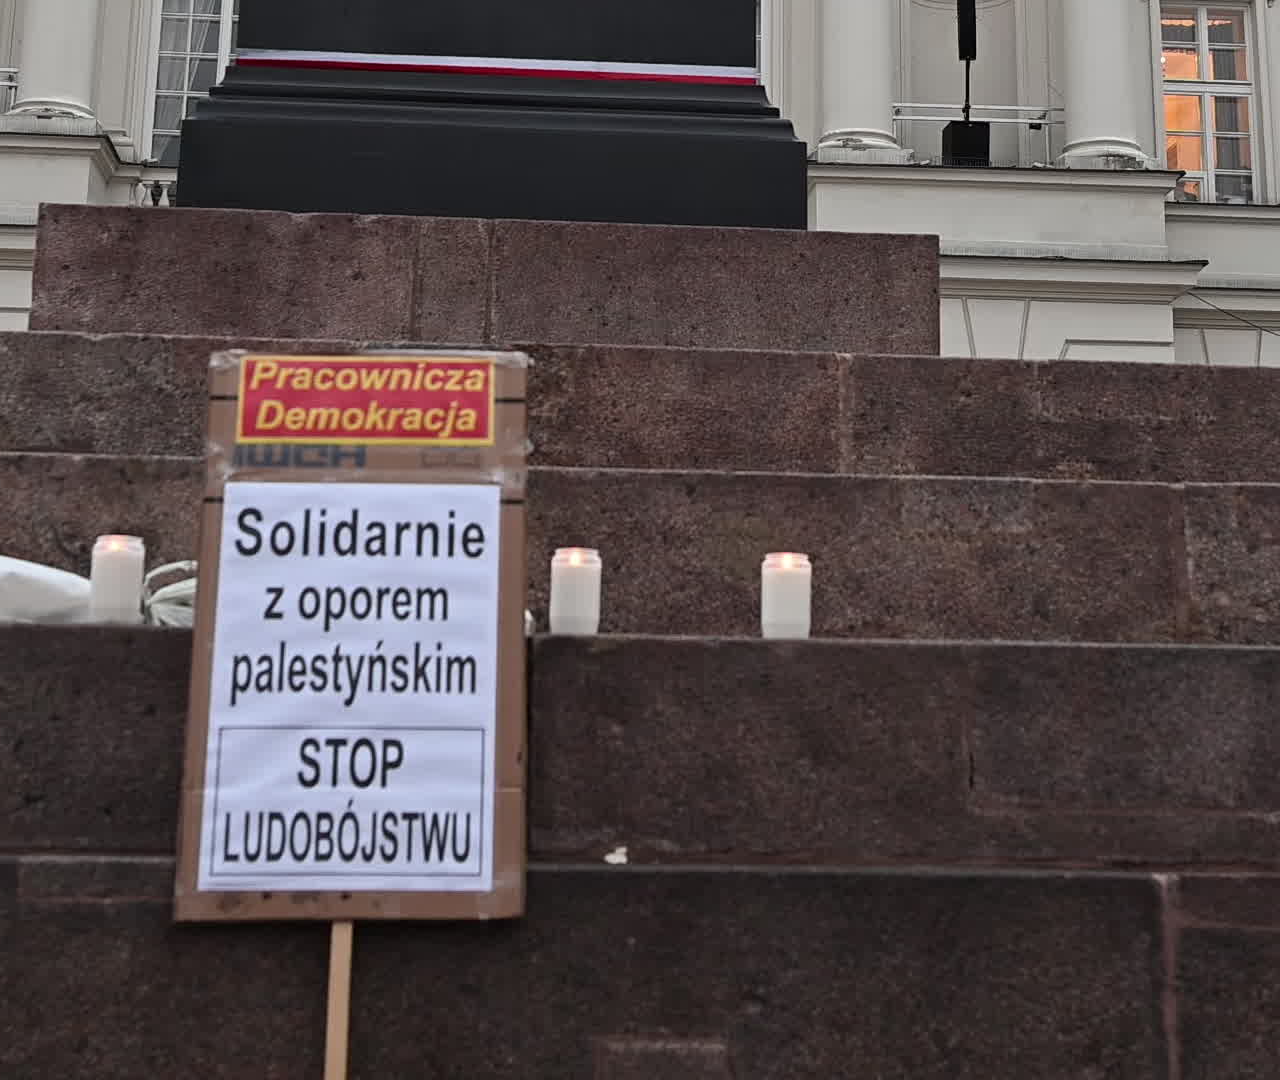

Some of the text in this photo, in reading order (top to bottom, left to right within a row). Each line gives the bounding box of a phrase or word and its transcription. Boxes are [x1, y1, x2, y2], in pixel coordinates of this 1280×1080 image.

[249, 360, 486, 392] Pracownicza
[255, 400, 478, 437] Demokracja
[235, 507, 485, 559] Solidarnie
[263, 586, 449, 633] z oporem
[230, 640, 477, 708] palestyńskim
[297, 737, 404, 789] STOP
[223, 799, 471, 863] LUDOBÓJSTWU
